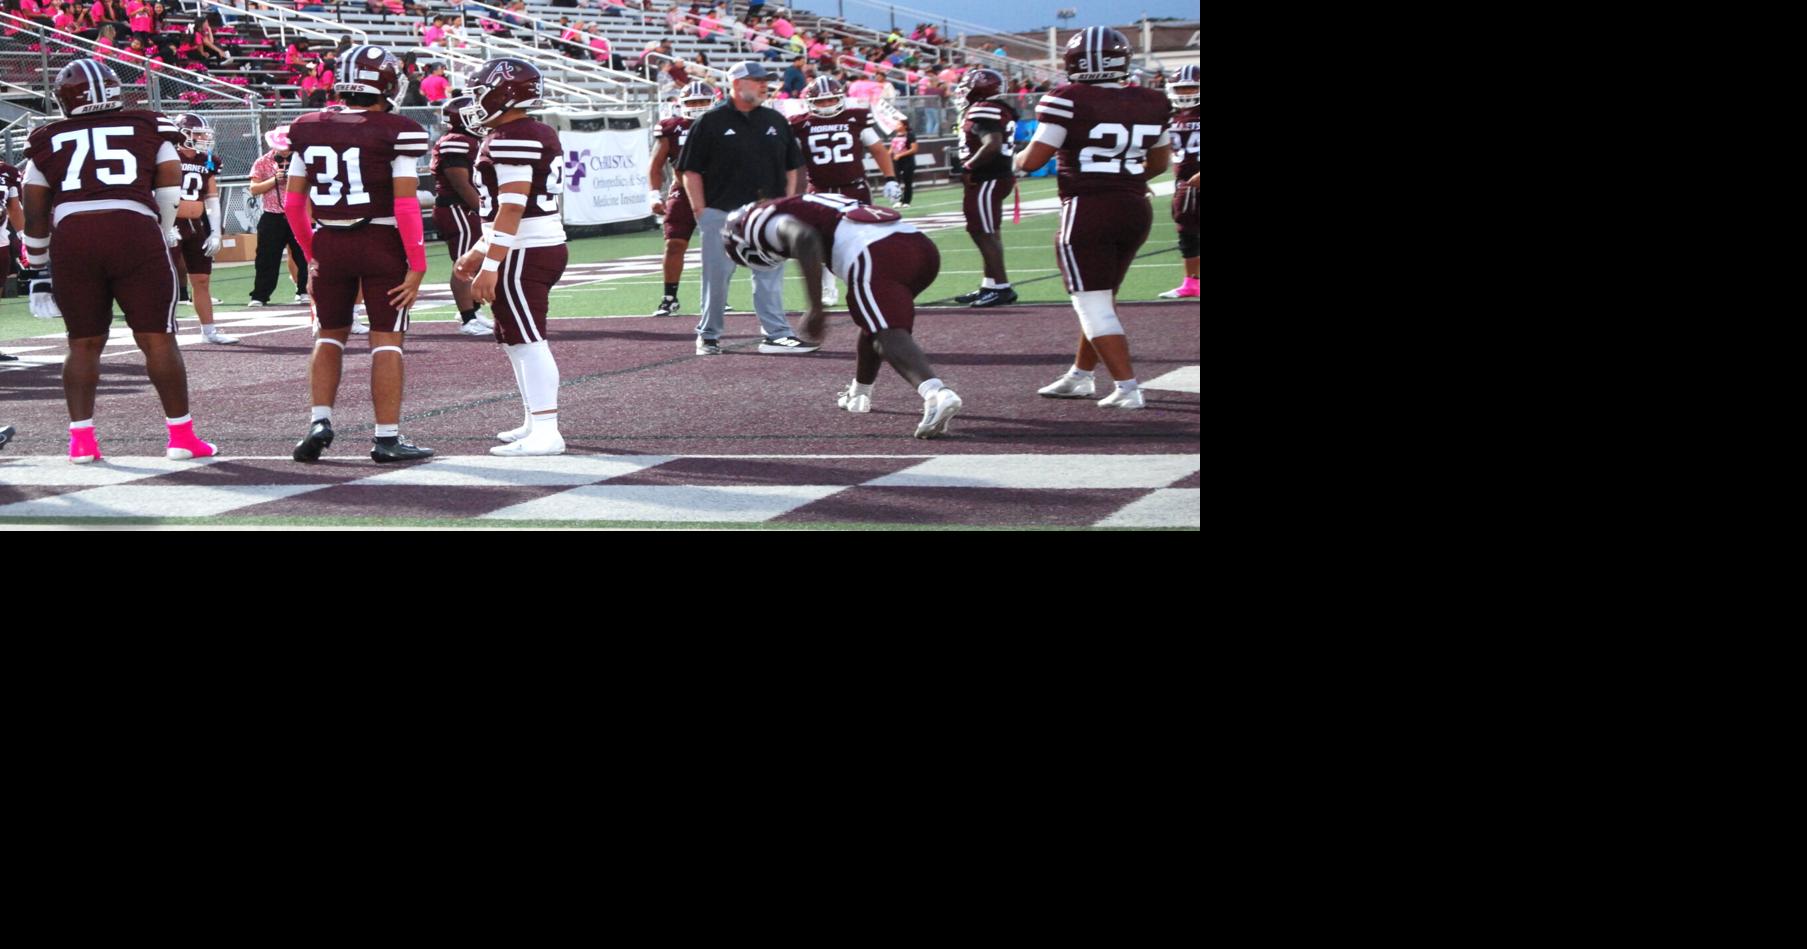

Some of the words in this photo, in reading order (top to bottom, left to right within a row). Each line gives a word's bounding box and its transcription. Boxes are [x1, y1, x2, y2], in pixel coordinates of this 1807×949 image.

[81, 102, 117, 113] ATHENS
[810, 124, 850, 133] HORNETS
[51, 126, 138, 191] 75
[808, 131, 854, 165] 52
[181, 162, 209, 173] ORNETS
[303, 145, 371, 206] 31
